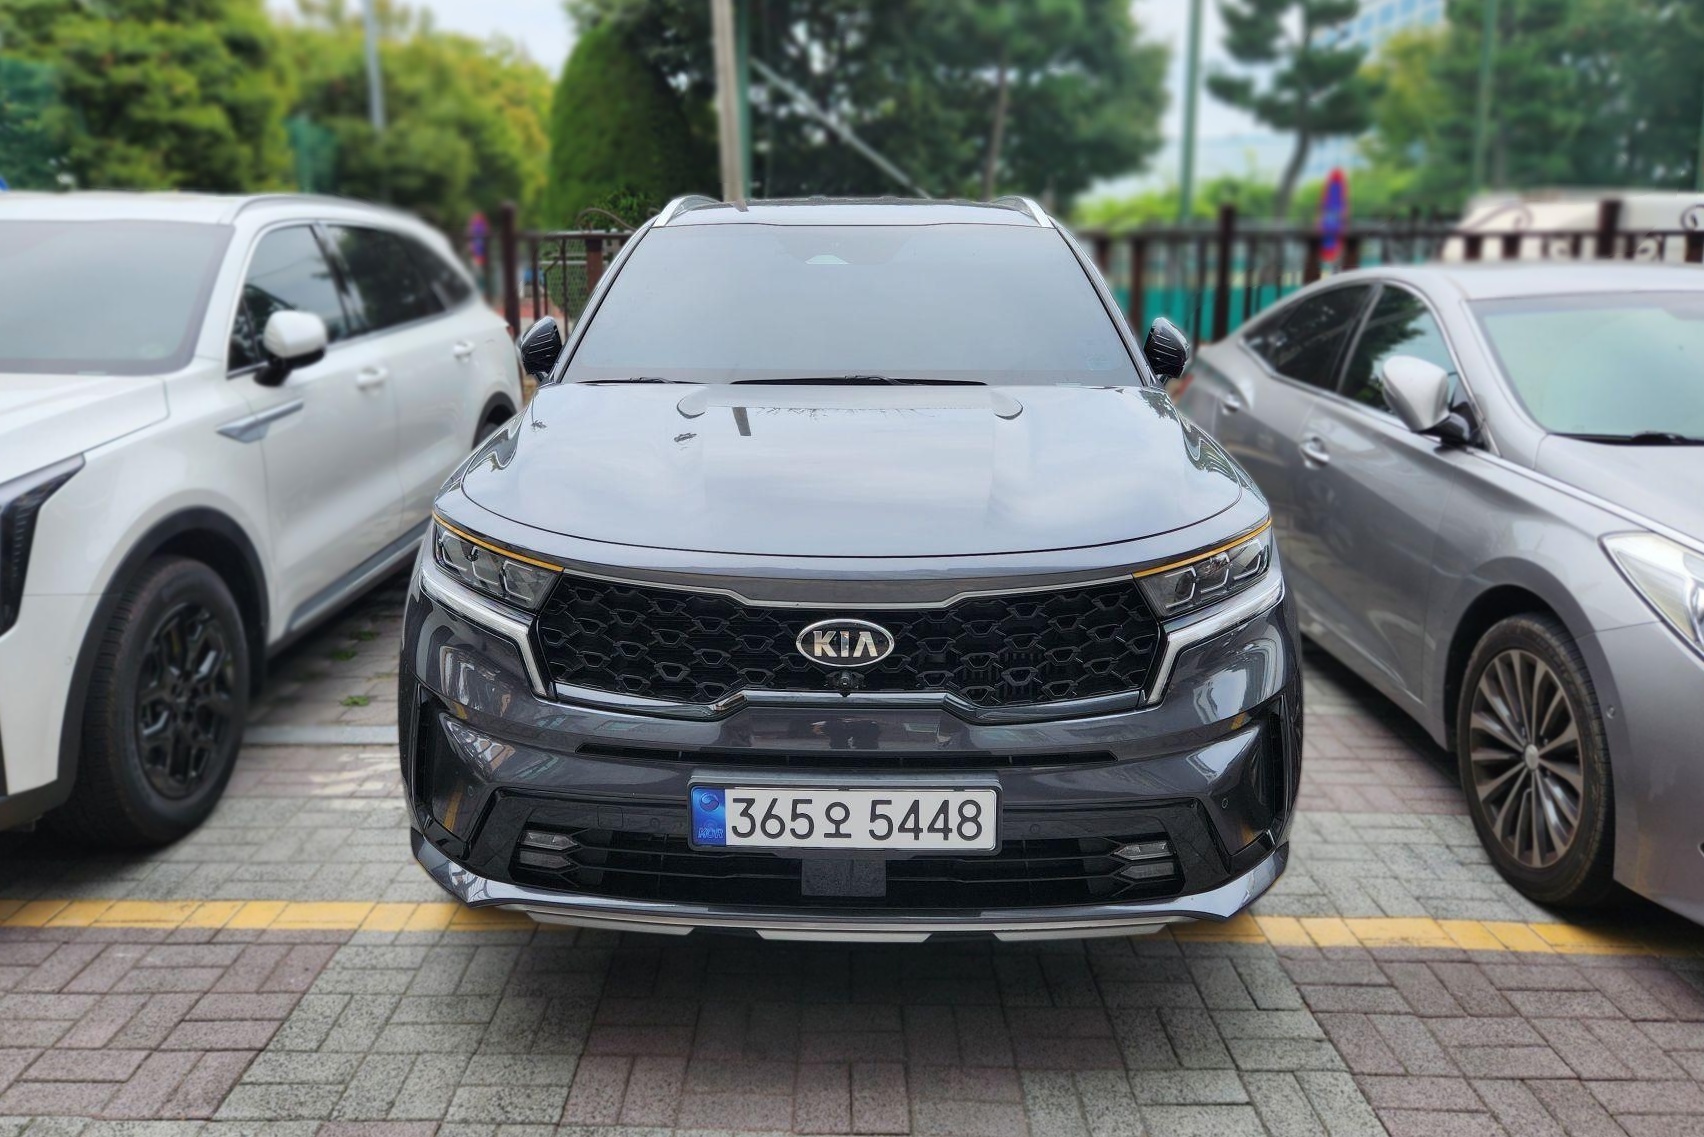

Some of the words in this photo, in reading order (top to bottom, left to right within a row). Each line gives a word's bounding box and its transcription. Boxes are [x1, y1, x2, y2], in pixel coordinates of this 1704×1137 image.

[813, 630, 878, 657] KIA
[731, 797, 852, 840] 365오
[868, 799, 983, 841] 5448
